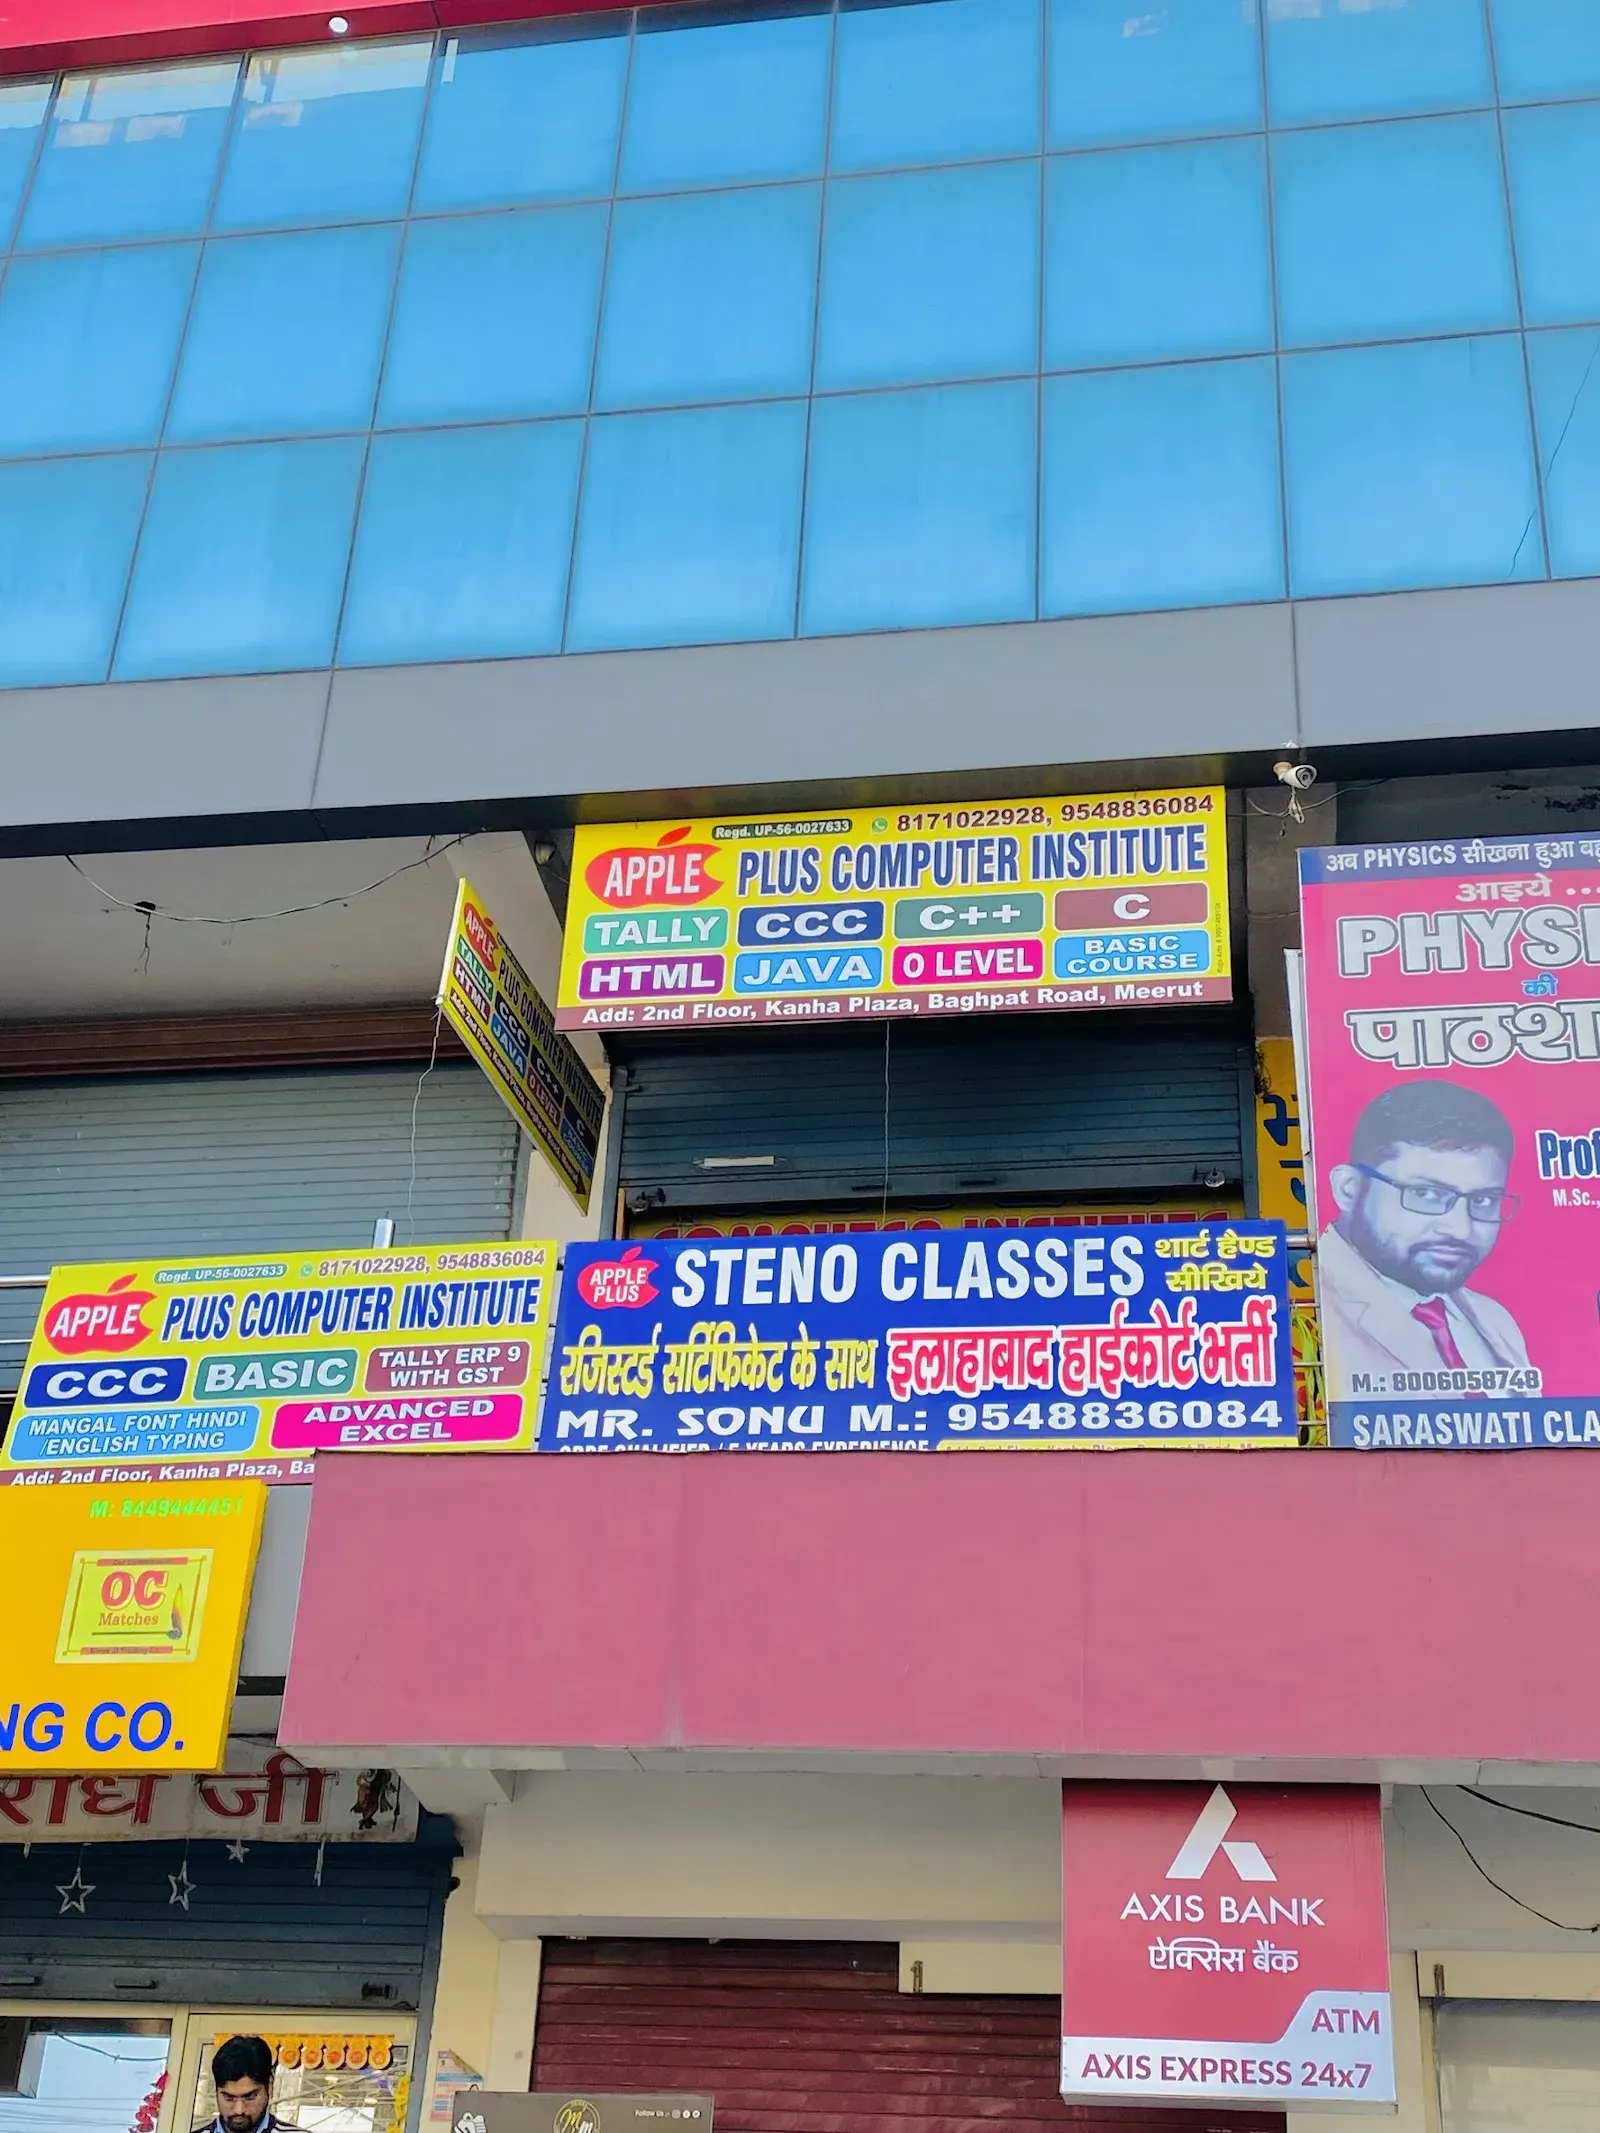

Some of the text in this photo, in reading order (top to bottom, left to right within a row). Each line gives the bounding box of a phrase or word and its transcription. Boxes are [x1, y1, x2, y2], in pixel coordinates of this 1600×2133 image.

[897, 795, 1214, 832] 8171022928, 9548836084
[715, 820, 850, 840] Regd. UP-56-0027633
[737, 825, 1207, 896] PLUS COMPUTER INSTITUTE
[1326, 853, 1359, 872] अब
[1364, 844, 1457, 868] PHYSICS
[1461, 839, 1530, 864] सीखना
[1534, 841, 1575, 869] हुआ
[603, 853, 702, 898] APPLE
[1455, 872, 1553, 903] आइये
[919, 904, 1021, 931] C++
[1113, 893, 1151, 920] C
[465, 905, 494, 964] APPLE
[594, 916, 721, 947] TALLY
[755, 909, 868, 939] CCC
[1085, 935, 1180, 956] BASIC
[458, 936, 492, 997] TALLY
[590, 963, 716, 993] HTML
[743, 955, 875, 986] JAVA
[936, 948, 1034, 978] LEVEL
[1067, 952, 1199, 975] COURSE
[454, 960, 488, 1021] HTML
[497, 956, 521, 1008] PLUS
[1522, 973, 1558, 997] की
[582, 981, 1203, 1025] Add: 2nd Floor, Kanha Plaza, Baghpat Road, Meerut
[498, 997, 527, 1050] CCC
[492, 1016, 524, 1075] JAVA
[535, 1054, 559, 1099] C++
[535, 1080, 559, 1126] LEVEL
[576, 1116, 585, 1139] C
[1155, 1228, 1211, 1258] शार्ट
[158, 1265, 285, 1283] Regd. UP-56-0027633
[319, 1250, 545, 1277] 8171022928, 9548836084
[590, 1267, 647, 1287] APPLE
[672, 1235, 1145, 1308] STENO CLASSES
[1165, 1262, 1268, 1292] सीखिये
[162, 1279, 542, 1341] PLUS COMPUTER INSTITUTE
[593, 1285, 640, 1304] PLUS
[50, 1304, 141, 1338] APPLE
[379, 1345, 521, 1368] TALLY ERP 9
[791, 1320, 821, 1390] के
[825, 1339, 879, 1391] साथ
[888, 1327, 1057, 1401] इलाहाबाद
[1059, 1297, 1200, 1399] हाईकोर्ट
[1200, 1296, 1277, 1388] भर्ती
[46, 1367, 169, 1400] CCC
[205, 1358, 349, 1393] BASIC
[390, 1367, 505, 1388] WITH GST
[1352, 1368, 1541, 1393] M.: 8006058748
[28, 1410, 248, 1437] MANGAL FONT HINDI
[303, 1400, 496, 1424] ADVANCED
[556, 1400, 1283, 1441] MR. SONU M.: 9548836084
[39, 1432, 225, 1457] /ENGLISH TYPING
[339, 1421, 453, 1443] EXCEL
[1354, 1411, 1533, 1447] SARASWATI
[11, 1472, 55, 1486] Add:
[59, 1470, 95, 1484] 2nd
[100, 1467, 153, 1483] Floor,
[159, 1465, 220, 1480] Kanha
[226, 1463, 283, 1479] Plaza,
[121, 1497, 243, 1518] 8449444451
[101, 1569, 169, 1611] OC
[98, 1612, 159, 1627] Matches
[85, 1702, 184, 1752] CO.
[195, 1751, 339, 1825] जी
[1120, 1893, 1327, 1926] AXIS BANK
[1252, 1938, 1299, 1974] बैंक
[1311, 2008, 1380, 2035] ATM
[1081, 2053, 1373, 2089] AXIS EXPRESS 24x7
